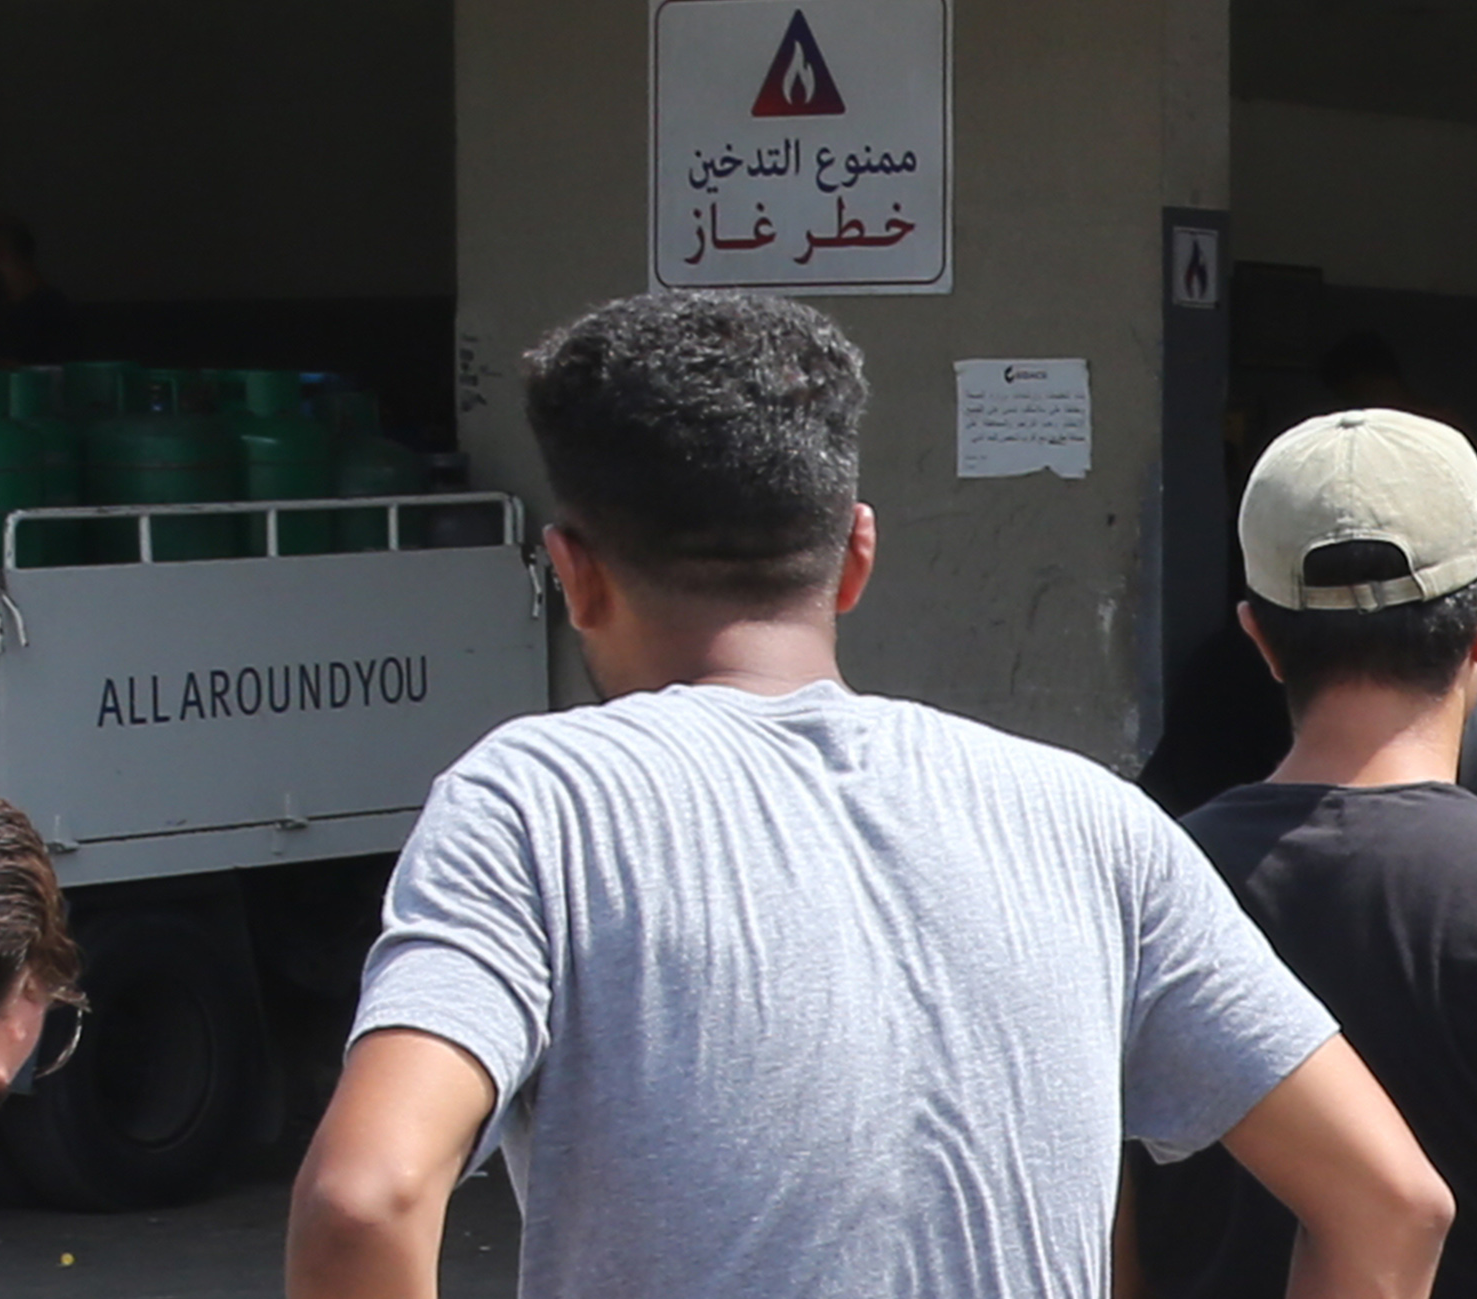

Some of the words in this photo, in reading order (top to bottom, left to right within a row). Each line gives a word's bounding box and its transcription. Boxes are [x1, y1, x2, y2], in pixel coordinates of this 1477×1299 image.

[688, 138, 800, 194] التدخين
[815, 145, 917, 193] ممنوع
[684, 202, 777, 265] غاز
[793, 195, 916, 265] خطر
